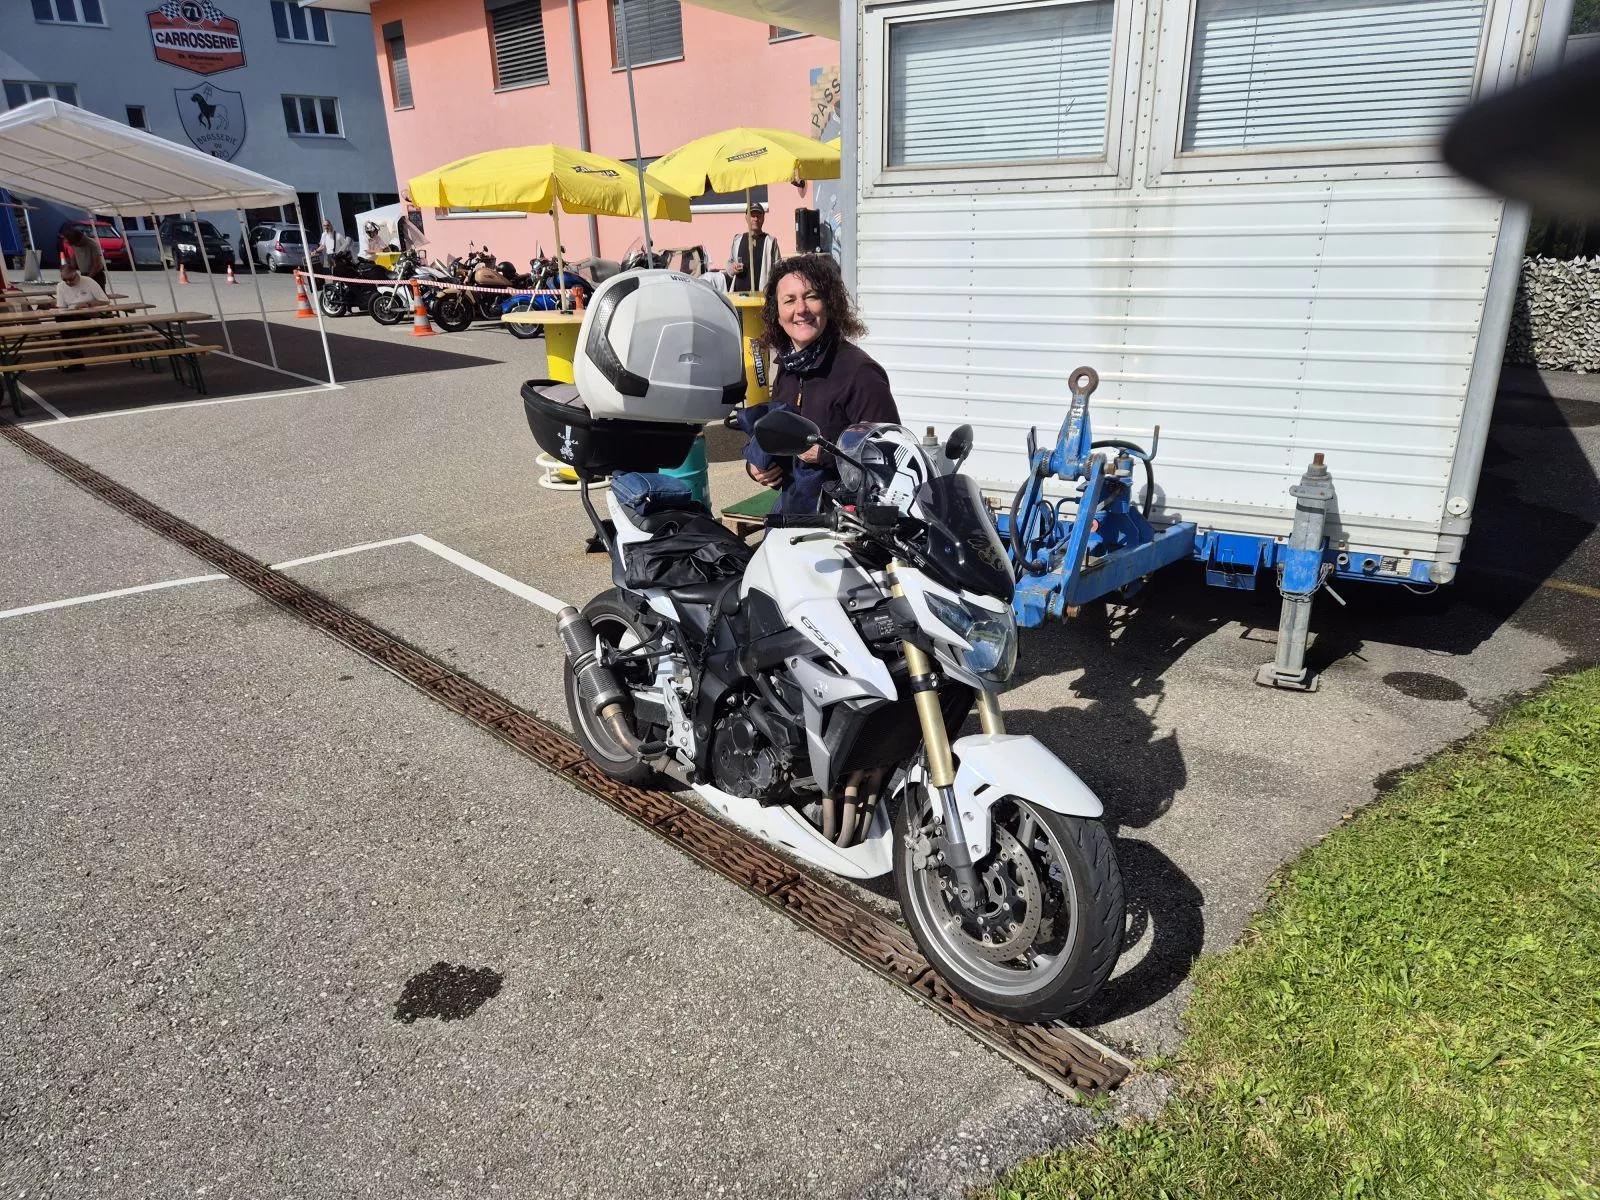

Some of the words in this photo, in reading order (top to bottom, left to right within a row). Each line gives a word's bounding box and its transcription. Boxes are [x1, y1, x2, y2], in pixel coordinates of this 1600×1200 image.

[183, 5, 201, 18] 71
[155, 31, 239, 49] CARROSSERIE
[800, 615, 841, 658] GSR
